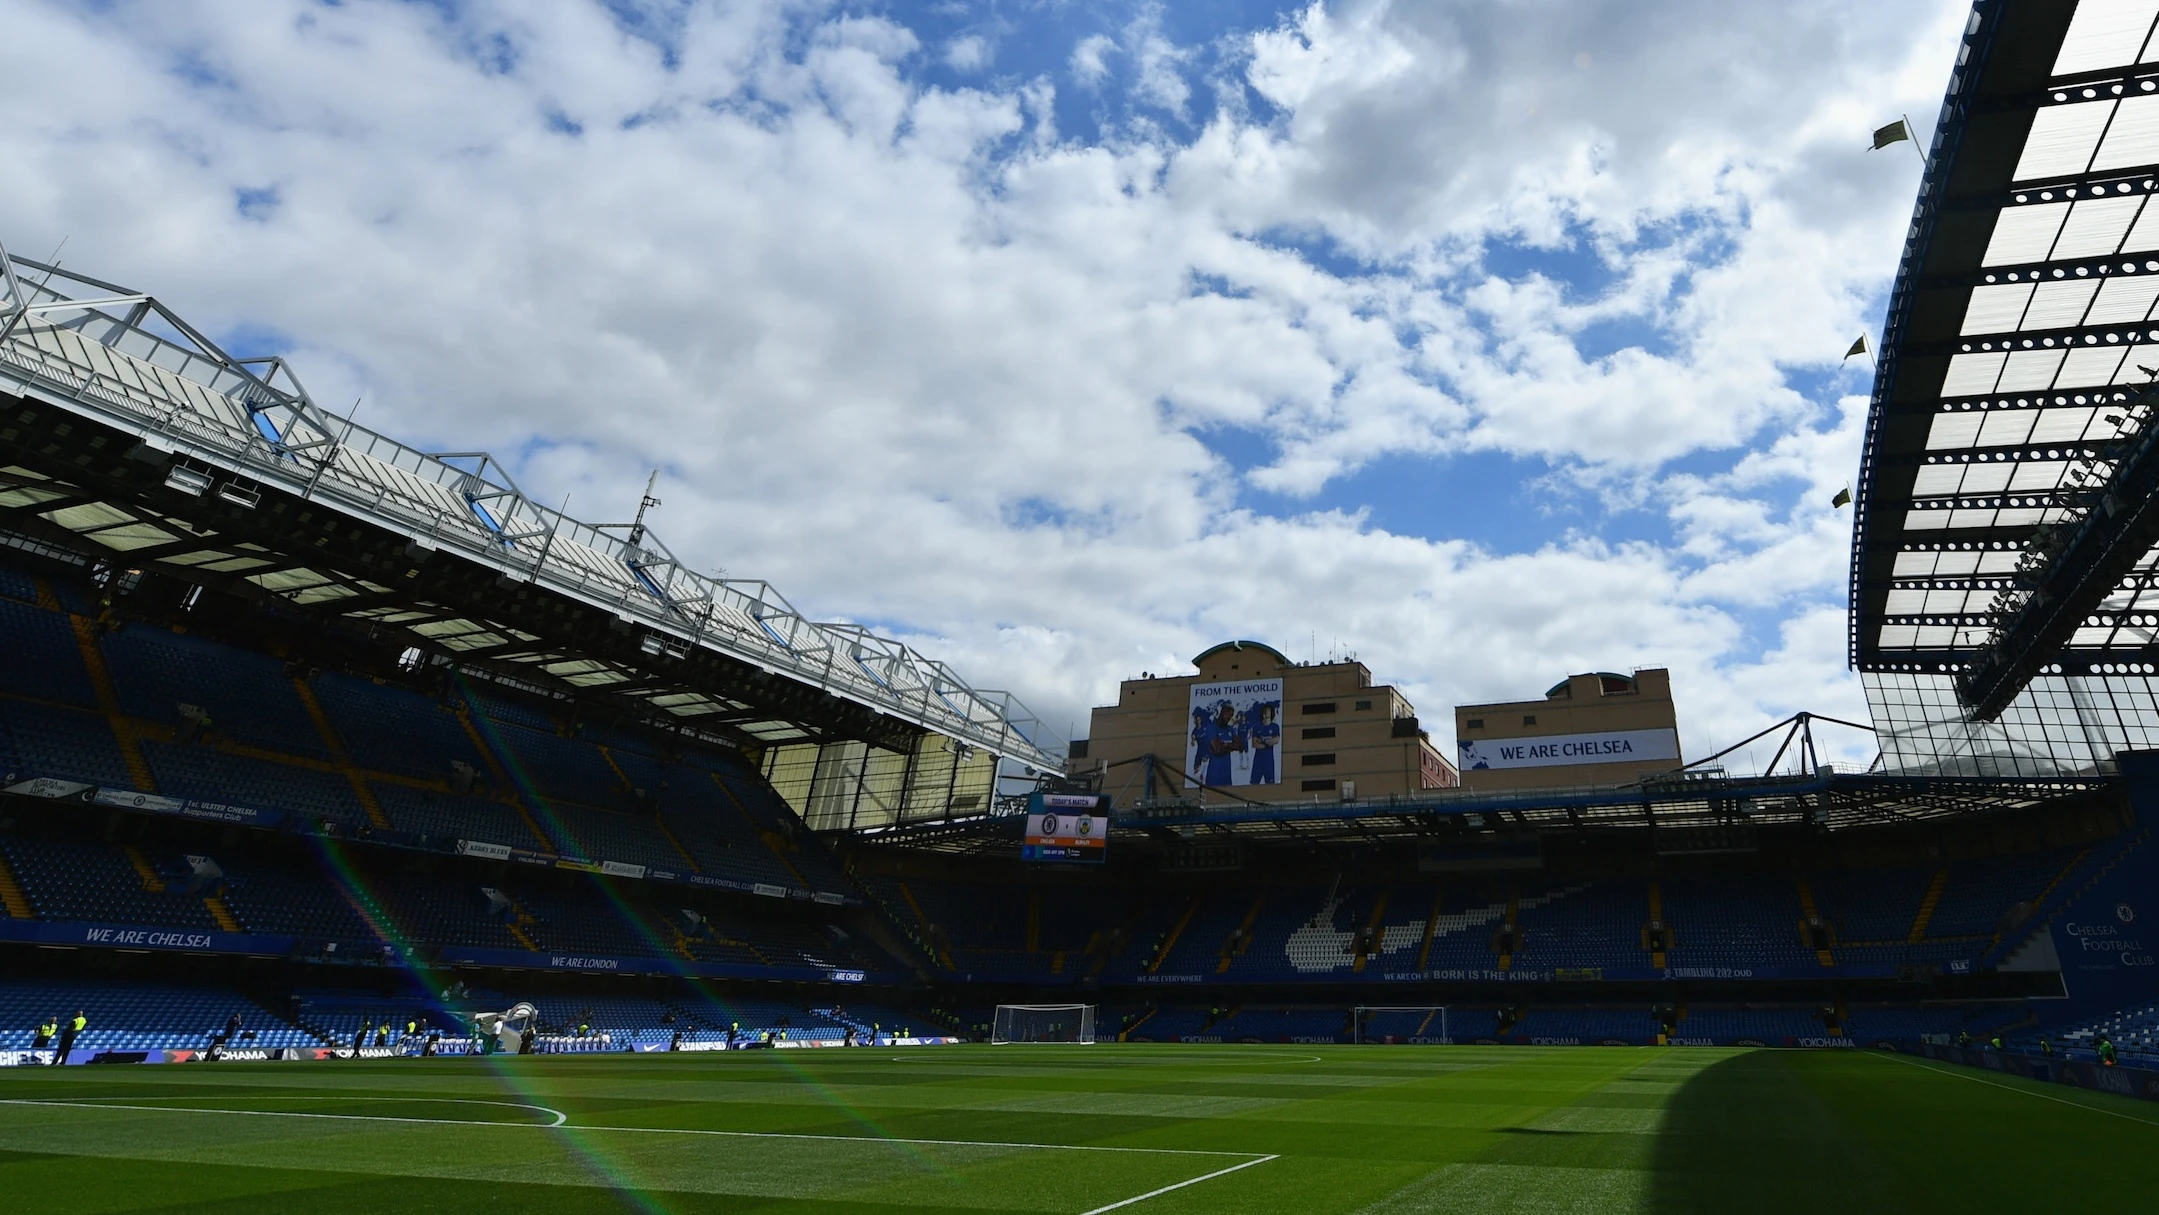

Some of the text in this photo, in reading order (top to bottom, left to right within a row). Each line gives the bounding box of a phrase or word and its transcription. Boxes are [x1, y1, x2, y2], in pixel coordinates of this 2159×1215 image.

[1195, 683, 1278, 697] FROM THE WORLD
[1500, 740, 1632, 760] WE ARE CHELSEA
[184, 807, 242, 821] Supporters Club
[201, 803, 226, 811] ULSTER
[227, 806, 258, 816] CHELSEA
[690, 875, 715, 885] CHELSEA
[714, 878, 741, 888] FOOTBALL
[2066, 922, 2118, 936] CHELSEA
[87, 928, 211, 948] WE ARE CHELSEA
[2081, 937, 2144, 951] FOOTBALL
[552, 957, 618, 969] WE ARE LONDON
[2121, 952, 2154, 966] CLUB
[1161, 975, 1203, 983] EVERYWHERE
[1384, 972, 1421, 981] WE ARE CH
[1433, 971, 1538, 981] BORN IS THE KING
[1674, 968, 1715, 978] TAMBLING
[1291, 1036, 1335, 1044] YOKOHAMA
[1531, 1037, 1580, 1045] YOKOHAMA
[1666, 1038, 1714, 1046] OKOHAMA
[1799, 1038, 1856, 1047] YOKOHAMA
[0, 1051, 60, 1065] CHELSE
